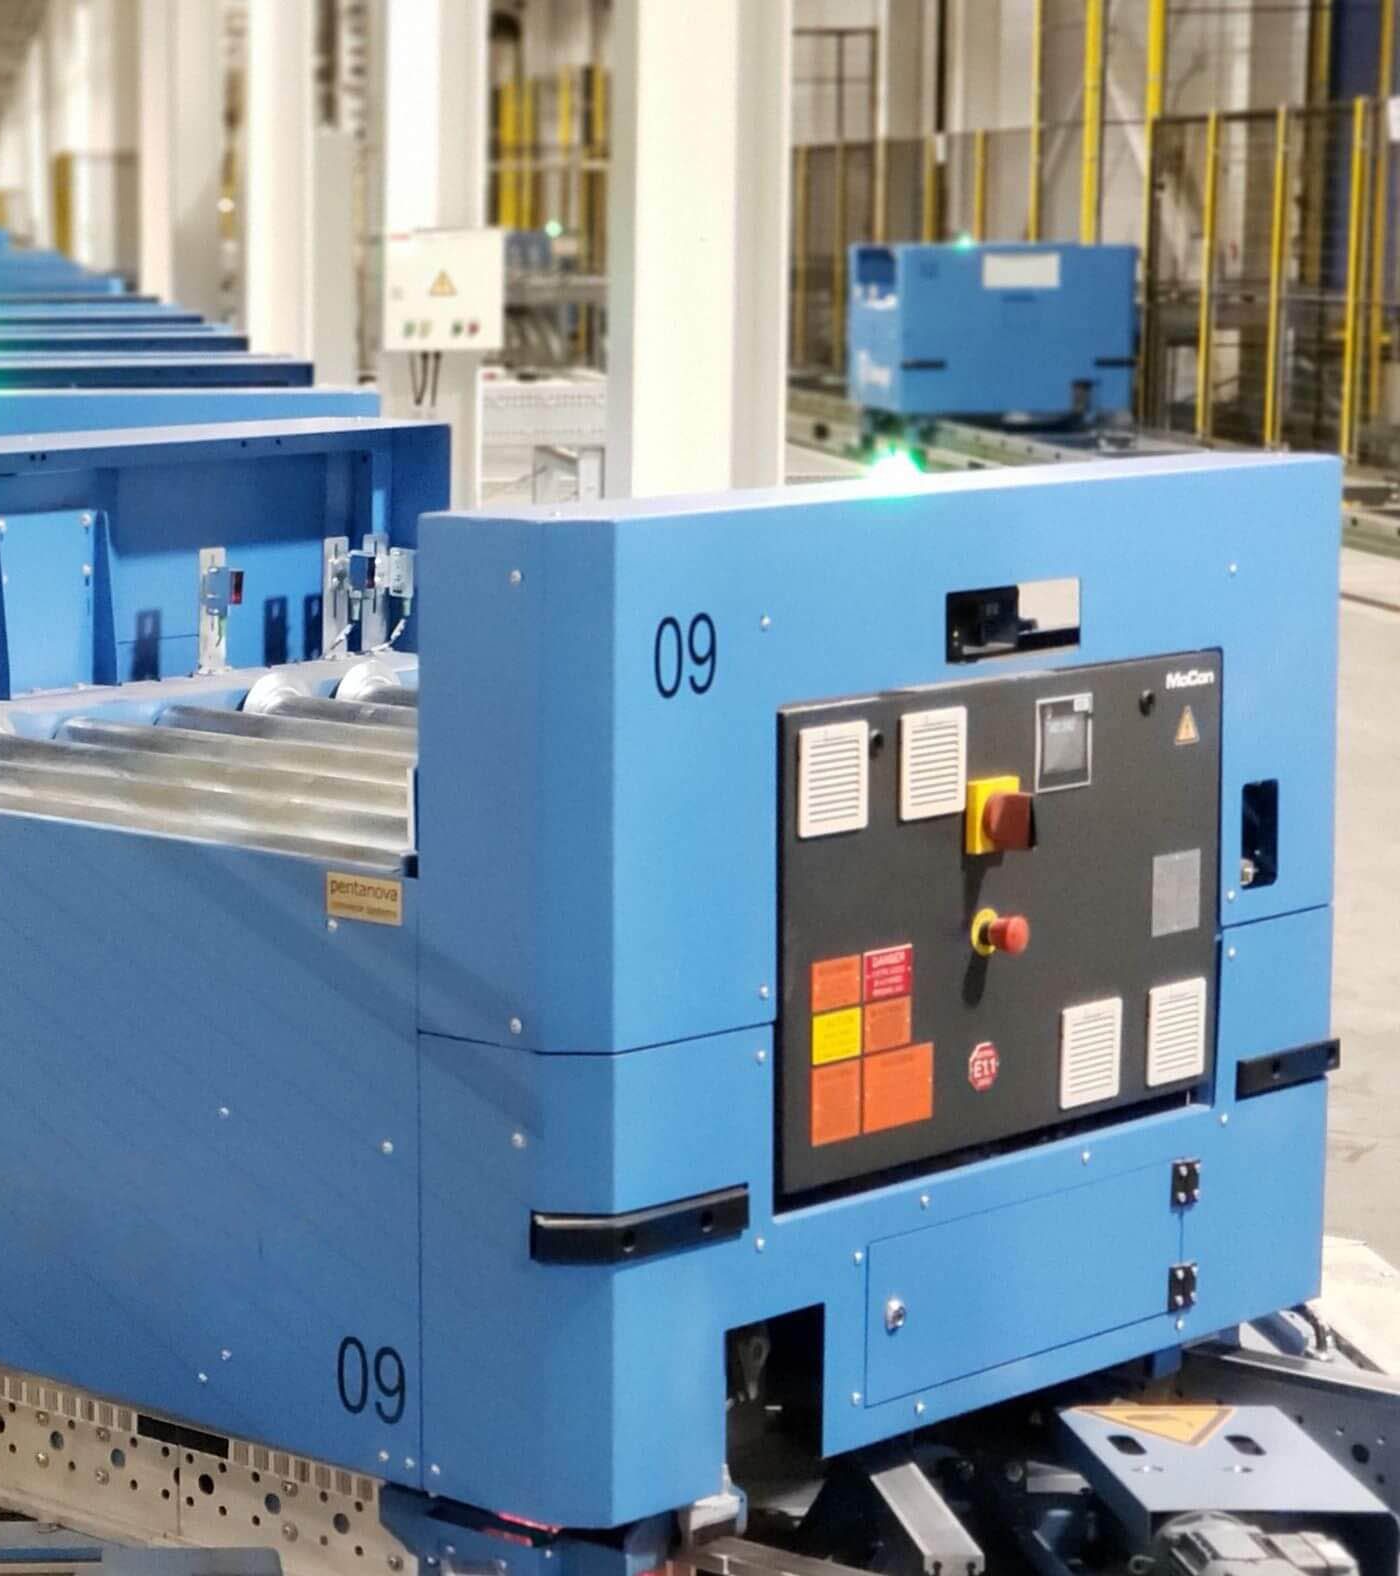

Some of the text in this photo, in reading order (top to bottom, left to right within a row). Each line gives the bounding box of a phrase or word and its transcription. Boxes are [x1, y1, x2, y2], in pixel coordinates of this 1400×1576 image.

[654, 612, 716, 699] 09
[1165, 670, 1214, 689] MoCon
[330, 880, 398, 901] pentanova
[338, 1336, 405, 1424] 09
